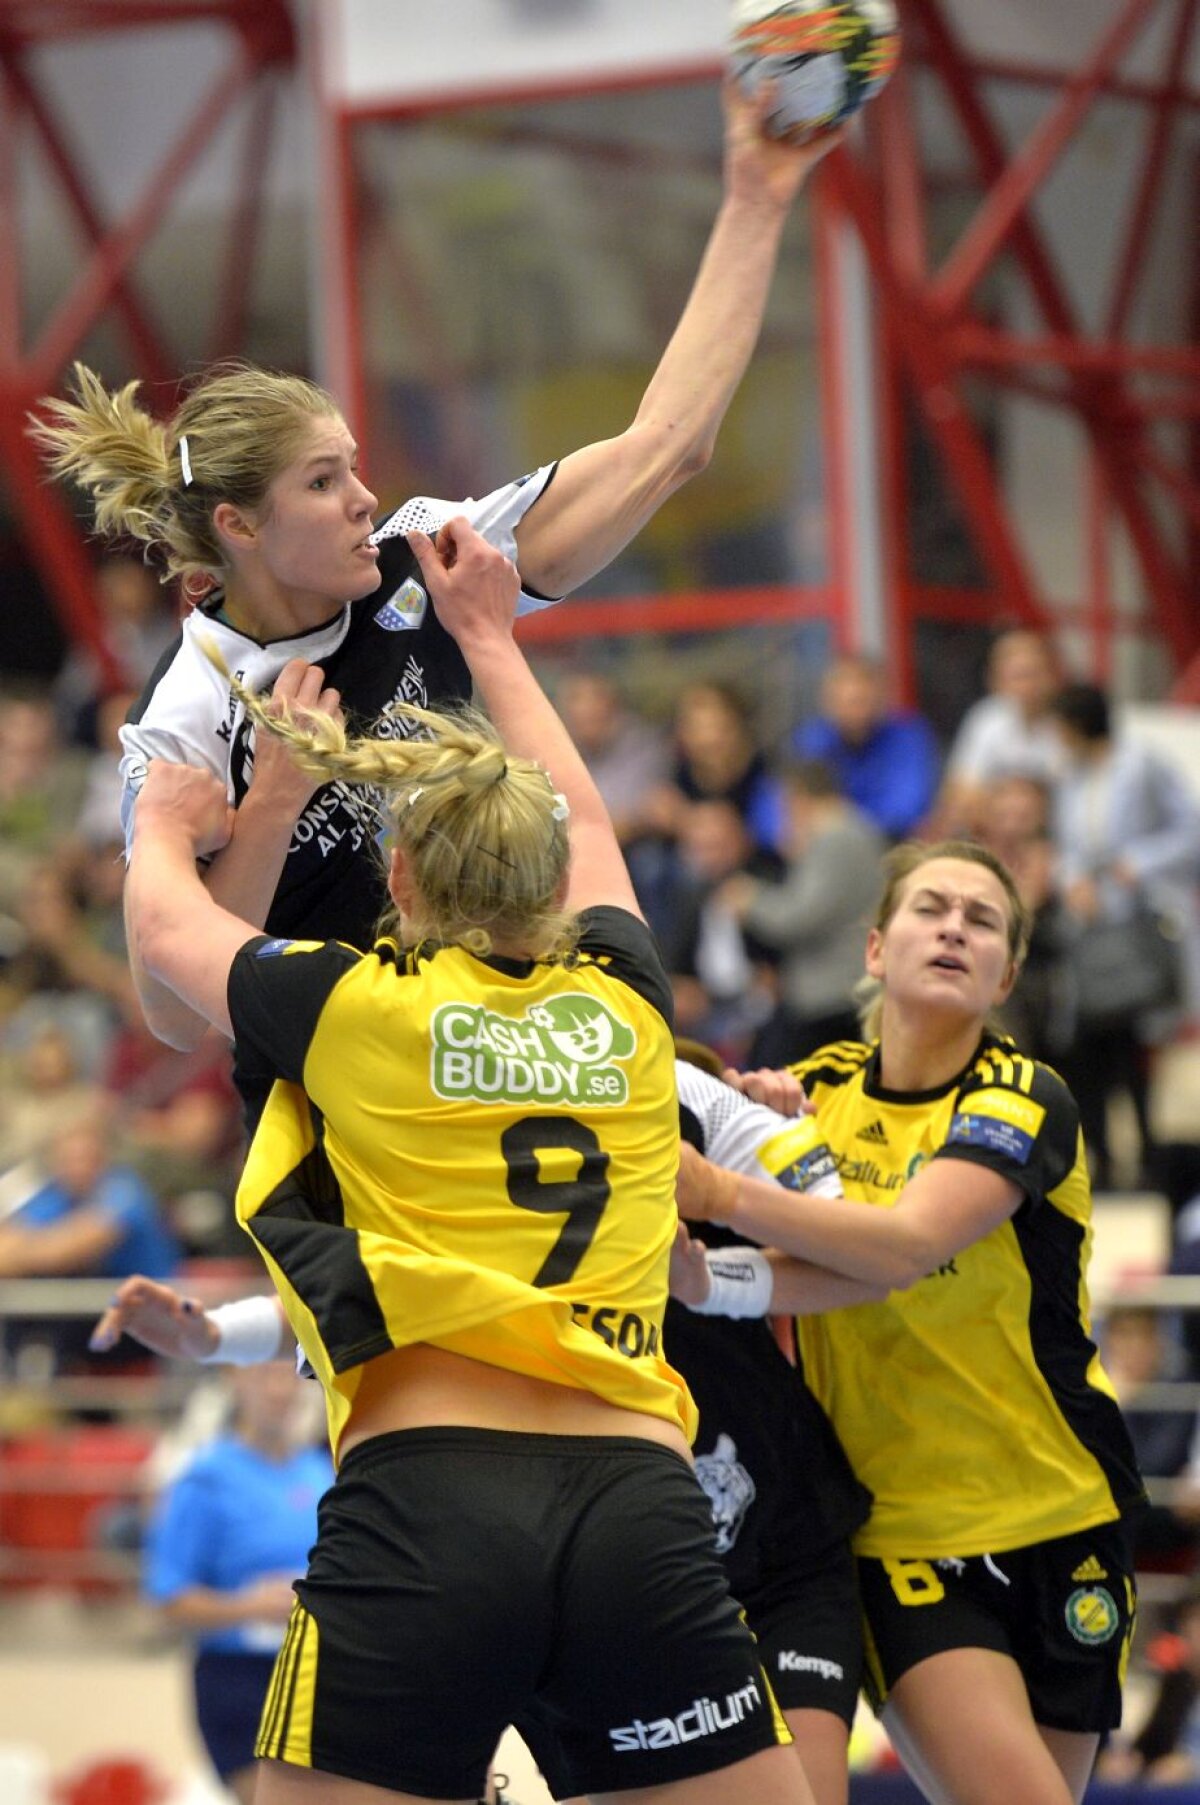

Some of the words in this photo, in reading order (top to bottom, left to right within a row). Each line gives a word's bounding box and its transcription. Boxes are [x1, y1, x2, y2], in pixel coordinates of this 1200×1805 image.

[443, 1012, 546, 1059] CASH
[501, 1116, 612, 1289] 9
[609, 1675, 761, 1751] stadium
